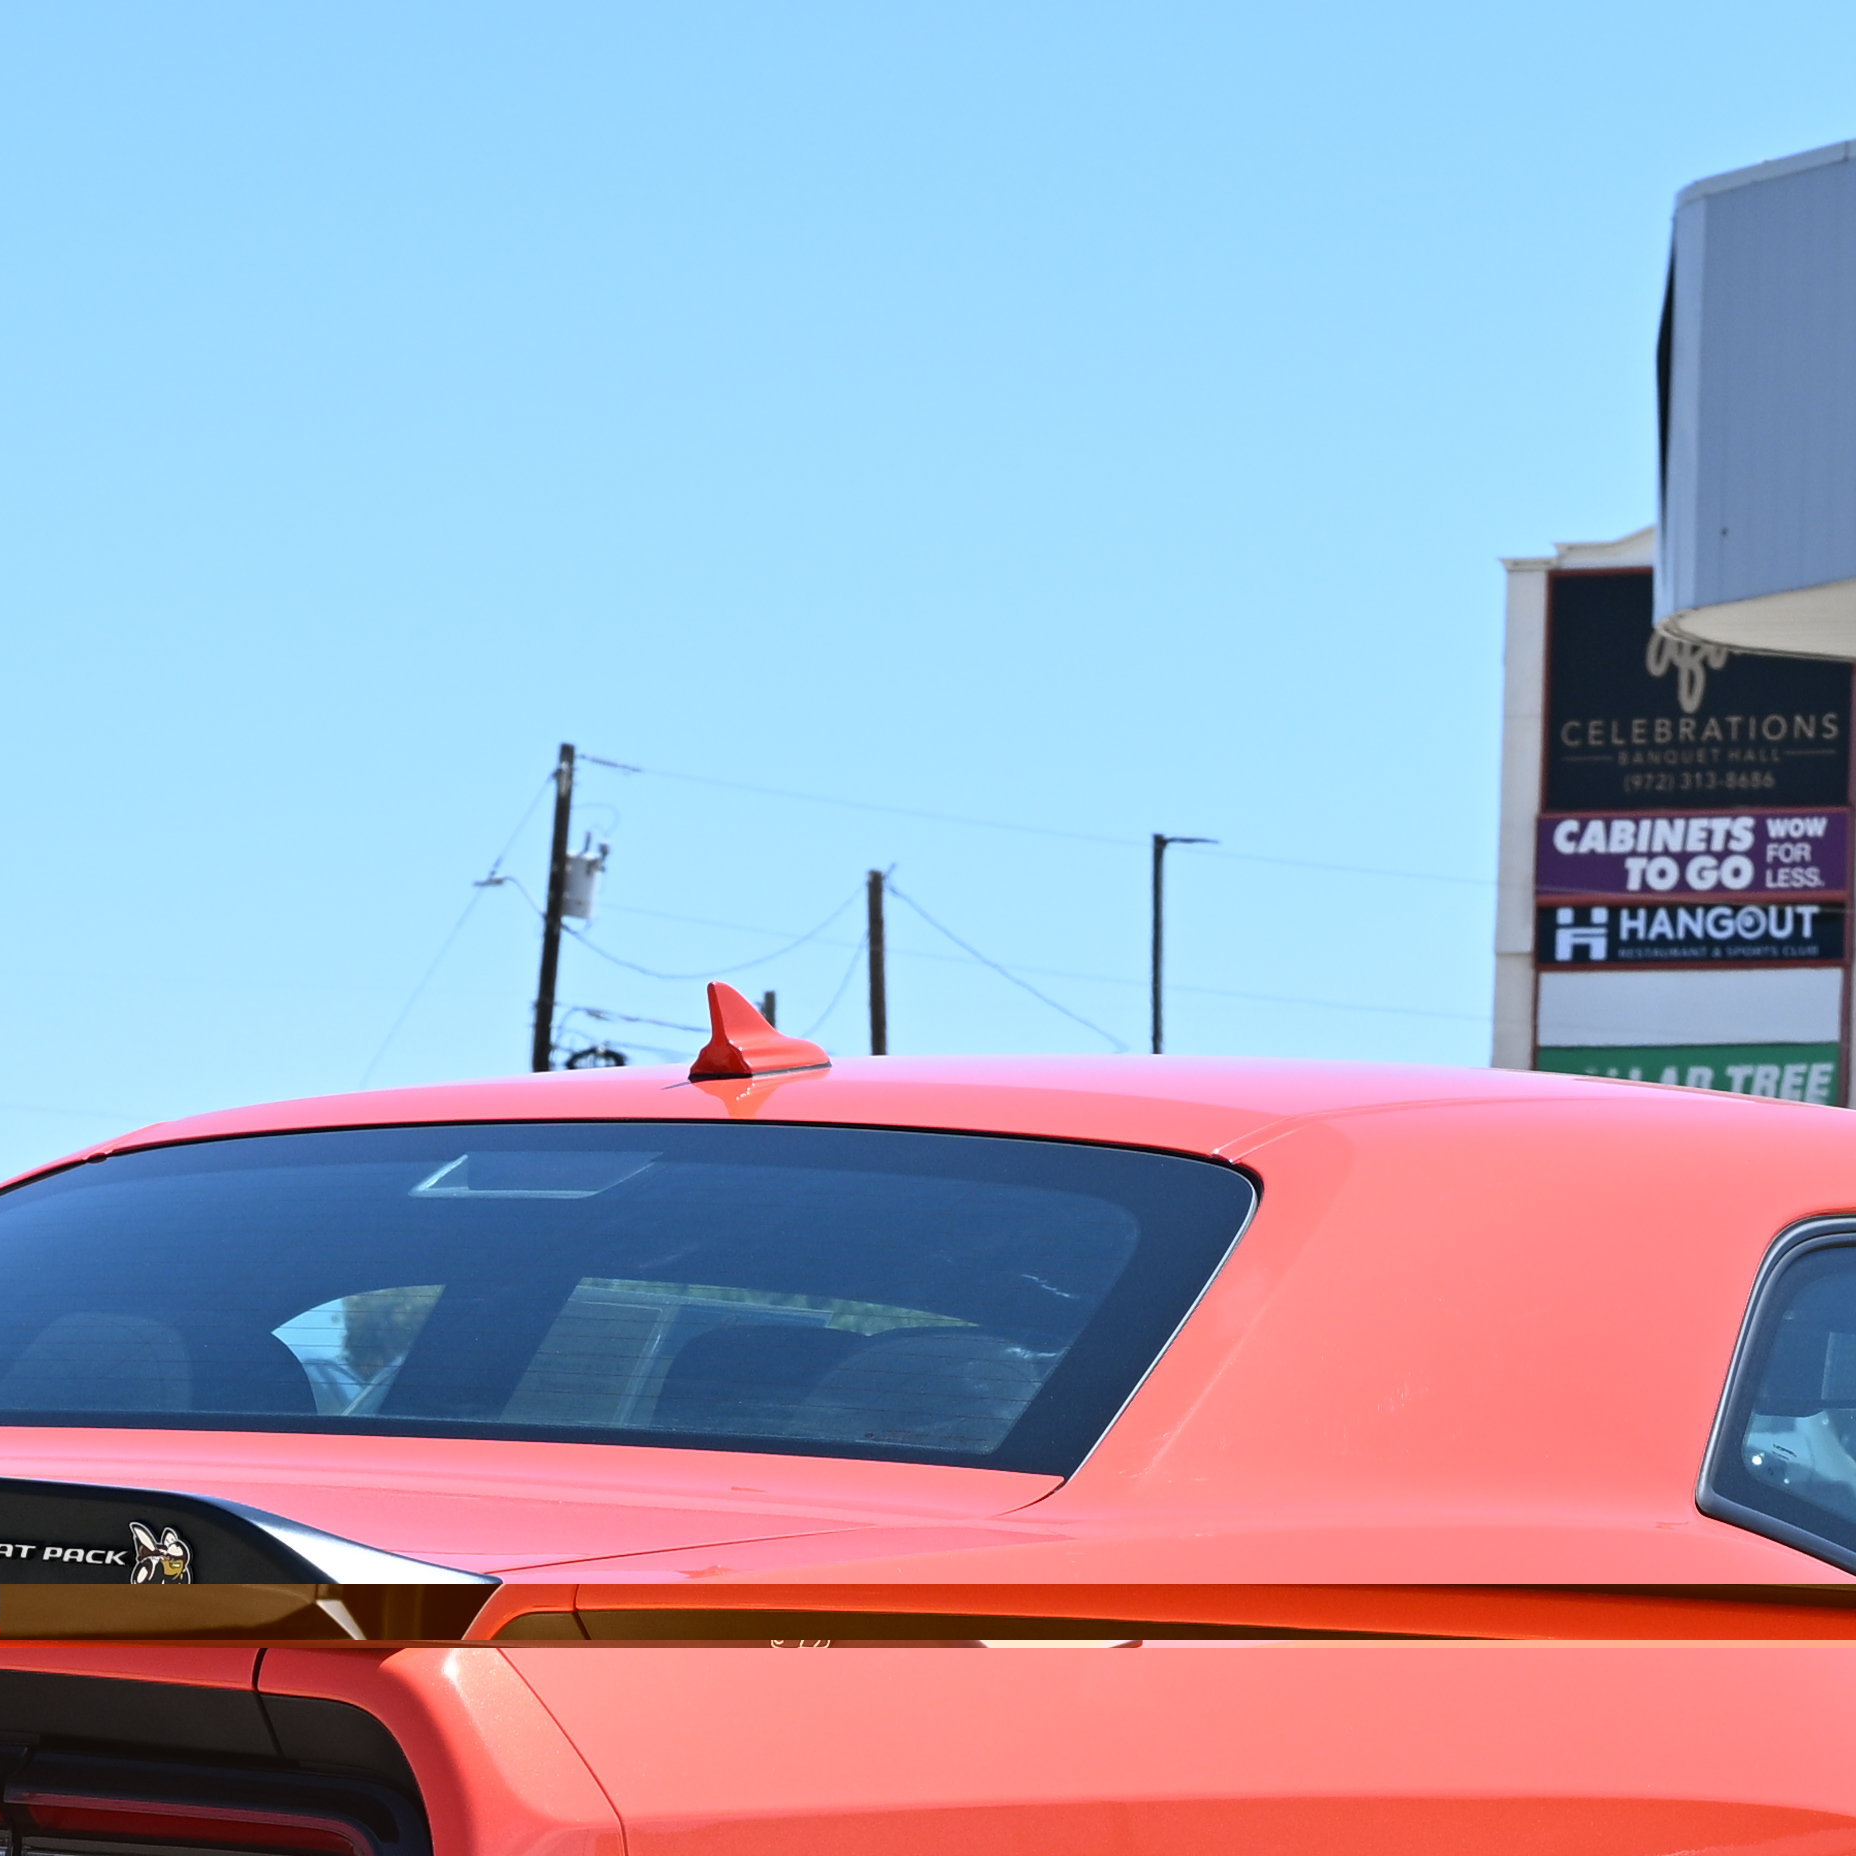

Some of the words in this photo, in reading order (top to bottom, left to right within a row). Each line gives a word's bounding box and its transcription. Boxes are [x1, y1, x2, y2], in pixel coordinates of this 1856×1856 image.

[1560, 713, 1840, 746] CELEBRATIONS
[1618, 747, 1720, 766] BANQUET
[1728, 747, 1781, 763] HALL
[1623, 772, 1674, 793] (972)
[1552, 816, 1755, 855] CABINETS
[1766, 817, 1828, 838] WOW
[1766, 843, 1812, 863] FOR
[1625, 856, 1680, 891] TO
[1685, 855, 1755, 891] GO
[1619, 905, 1820, 941] HANGOUT
[1725, 1062, 1834, 1105] TREE
[42, 1546, 128, 1566] PACK
